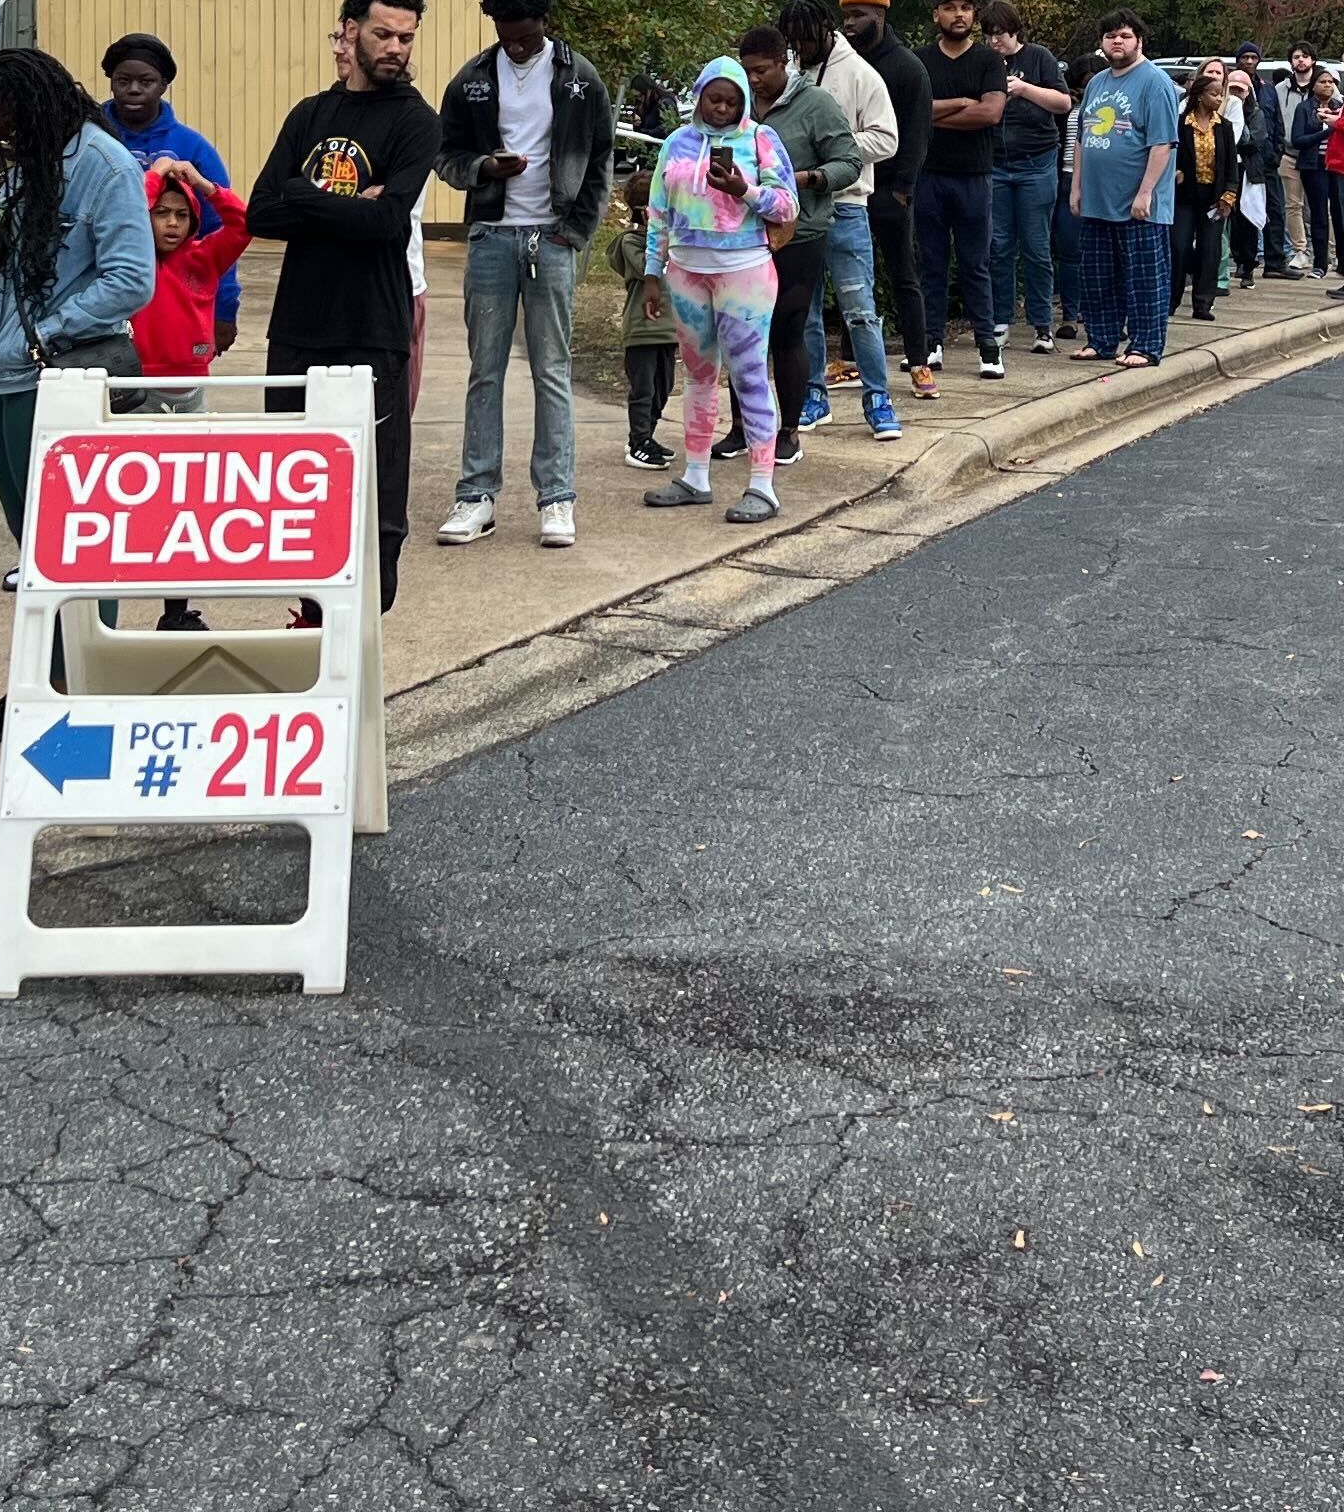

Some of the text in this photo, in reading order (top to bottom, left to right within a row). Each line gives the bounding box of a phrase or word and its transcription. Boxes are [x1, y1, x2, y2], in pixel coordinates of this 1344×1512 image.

[316, 140, 357, 157] OLO
[1084, 136, 1111, 150] 1980
[57, 449, 329, 506] VOTING
[60, 508, 317, 565] PLACE
[129, 721, 203, 750] PCT.
[134, 710, 325, 798] # 212
